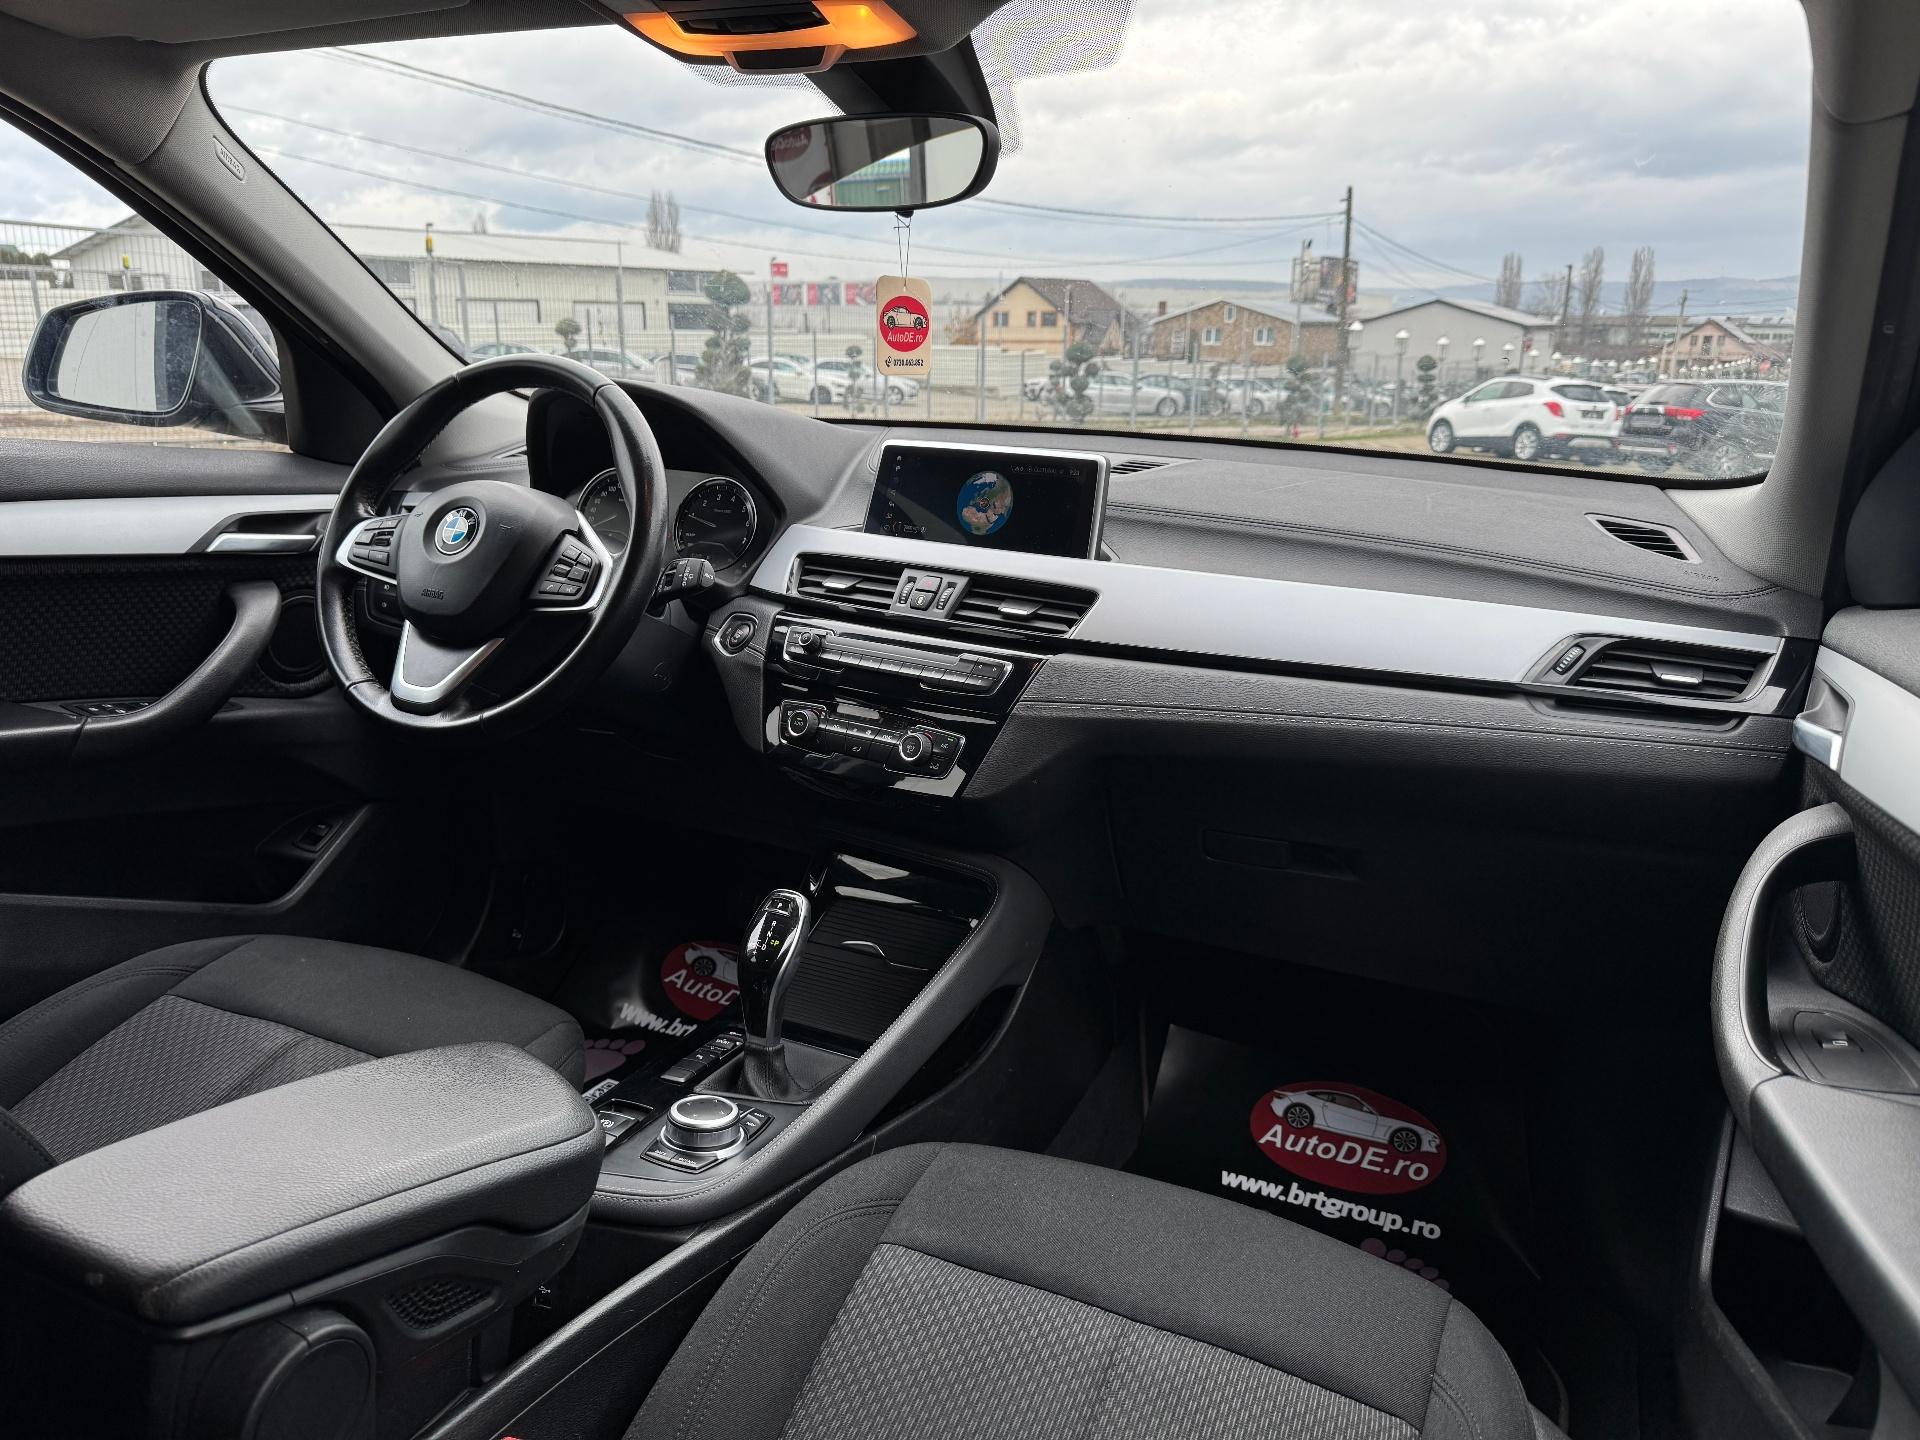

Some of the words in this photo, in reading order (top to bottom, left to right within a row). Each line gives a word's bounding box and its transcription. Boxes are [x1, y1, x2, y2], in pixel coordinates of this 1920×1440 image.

[886, 331, 924, 343] AutoDE.ro
[446, 510, 476, 526] BMW
[1259, 1124, 1429, 1181] AutoDE.ro
[1221, 1170, 1441, 1239] www.brtgroup.ro
